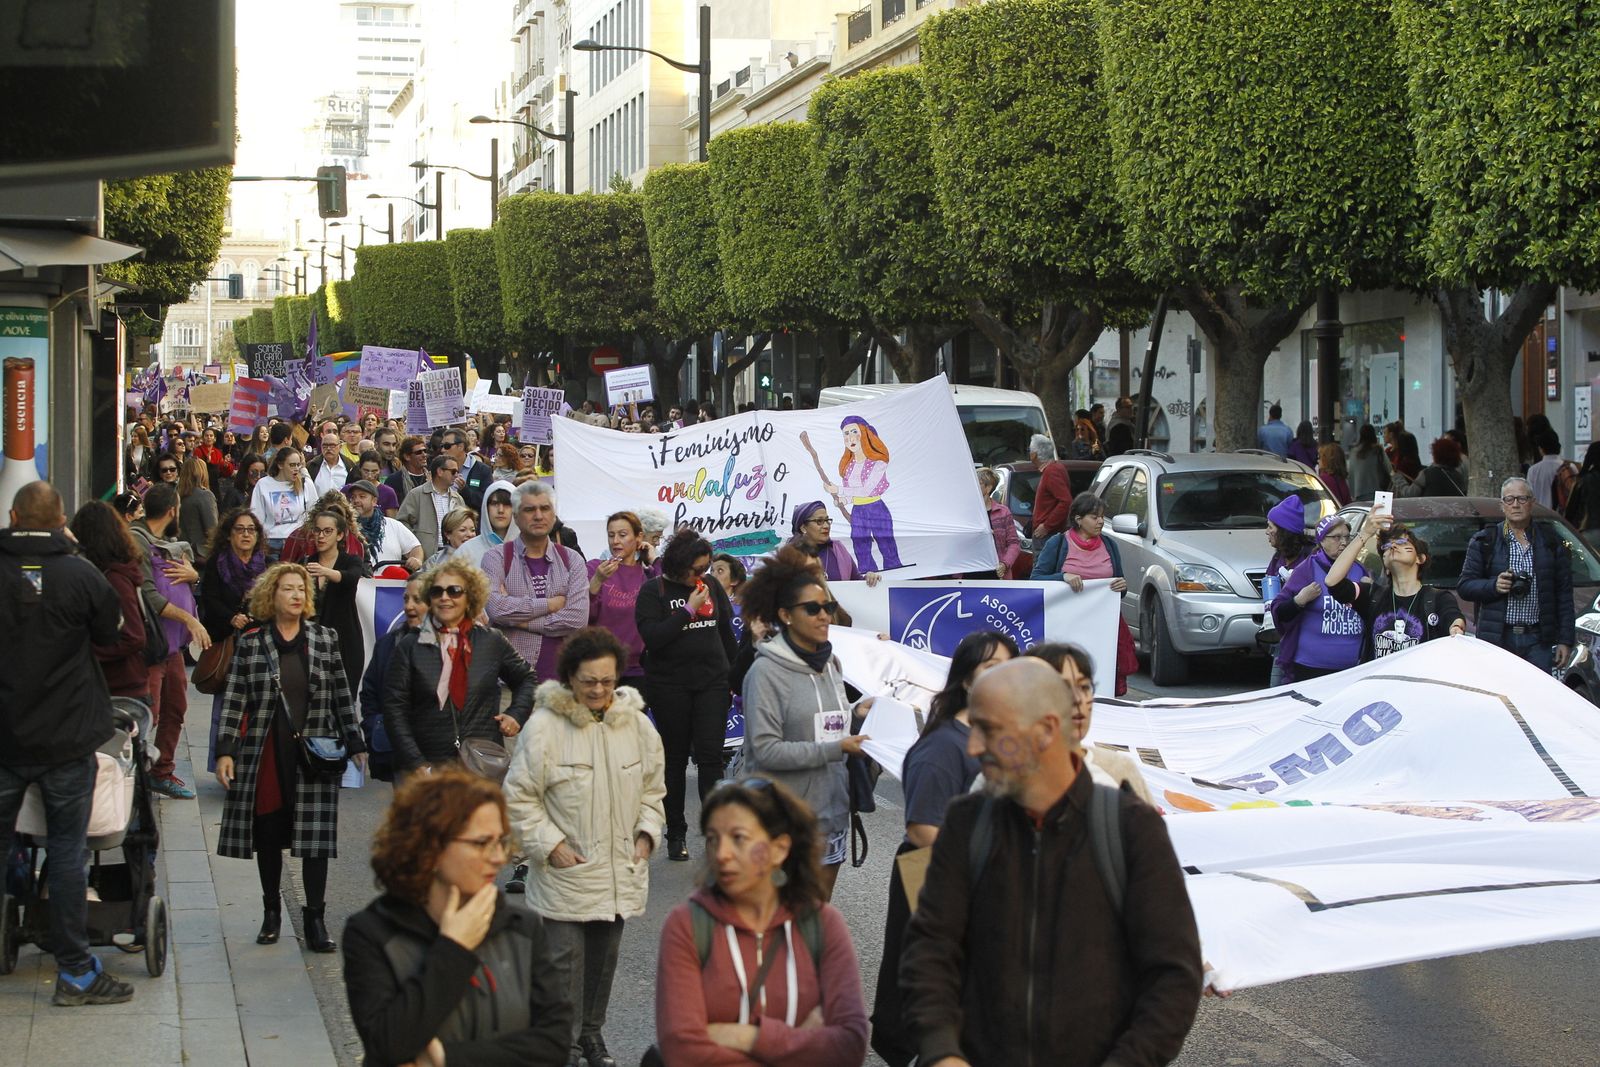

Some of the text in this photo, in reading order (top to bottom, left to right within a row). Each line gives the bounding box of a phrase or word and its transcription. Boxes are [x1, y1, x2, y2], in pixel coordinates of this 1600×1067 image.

[3, 326, 31, 335] AOVE
[257, 344, 282, 354] SOMOS
[263, 352, 283, 361] GRITO
[423, 369, 459, 382] SOLO YO
[425, 379, 460, 392] DECIDO
[444, 389, 461, 397] TOCA
[526, 388, 562, 401] SOLO YO
[17, 380, 26, 431] esencia
[525, 398, 561, 411] DECIDO
[1577, 407, 1588, 429] 25
[648, 422, 776, 469] ¡Feminismo
[658, 455, 790, 504] andaluz o
[670, 598, 686, 610] no
[1323, 609, 1345, 622] CON
[1321, 620, 1362, 635] MUJERES
